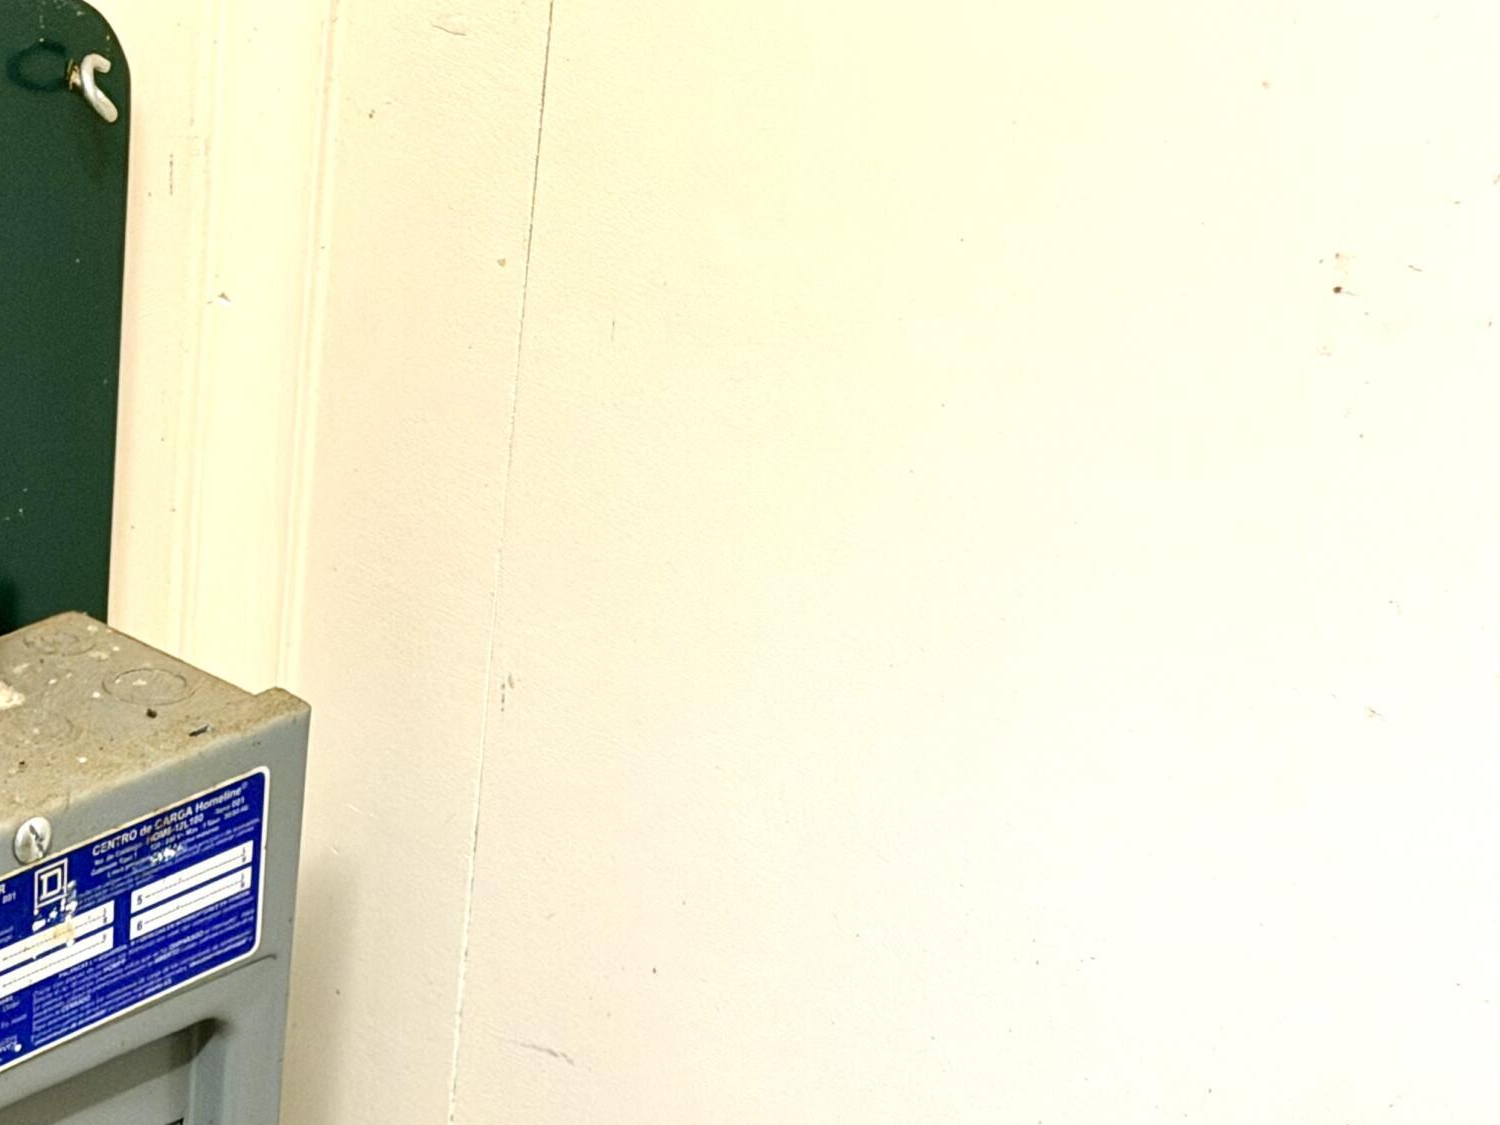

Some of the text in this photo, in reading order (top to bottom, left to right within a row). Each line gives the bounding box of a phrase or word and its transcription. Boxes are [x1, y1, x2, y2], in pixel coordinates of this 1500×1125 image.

[92, 830, 138, 857] CENTRO
[139, 824, 153, 837] de
[154, 805, 193, 831] CARGA
[137, 894, 143, 905] 5
[137, 919, 143, 931] 6
